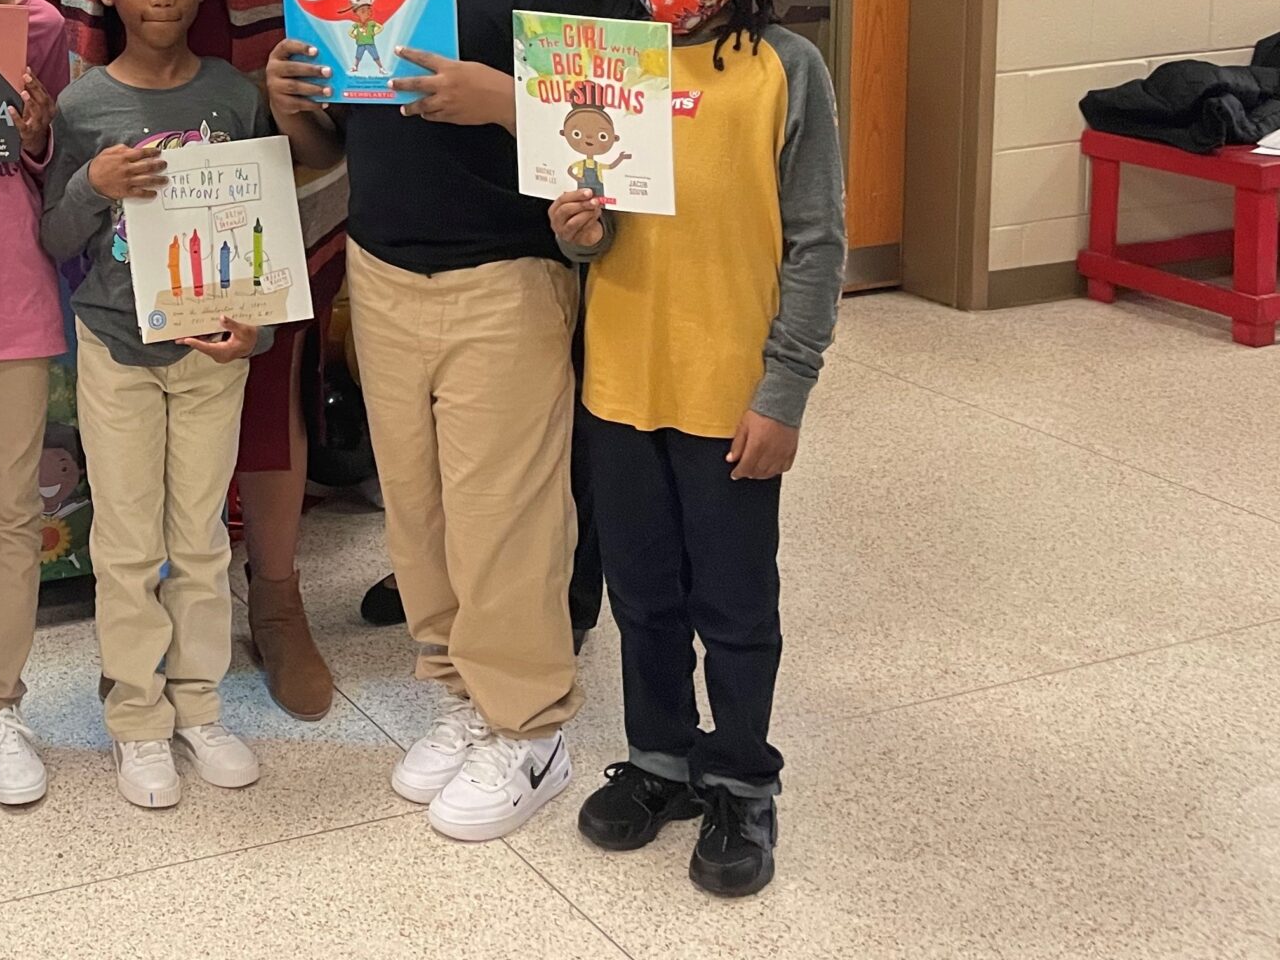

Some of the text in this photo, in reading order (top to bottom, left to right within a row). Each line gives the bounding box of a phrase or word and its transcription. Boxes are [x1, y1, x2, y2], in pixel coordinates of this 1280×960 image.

[538, 24, 641, 57] The GIRL with
[592, 55, 626, 83] BIG
[537, 79, 646, 115] QUESTIONS
[171, 167, 249, 186] THE DAY the
[163, 182, 259, 201] CRAYONS QUIT
